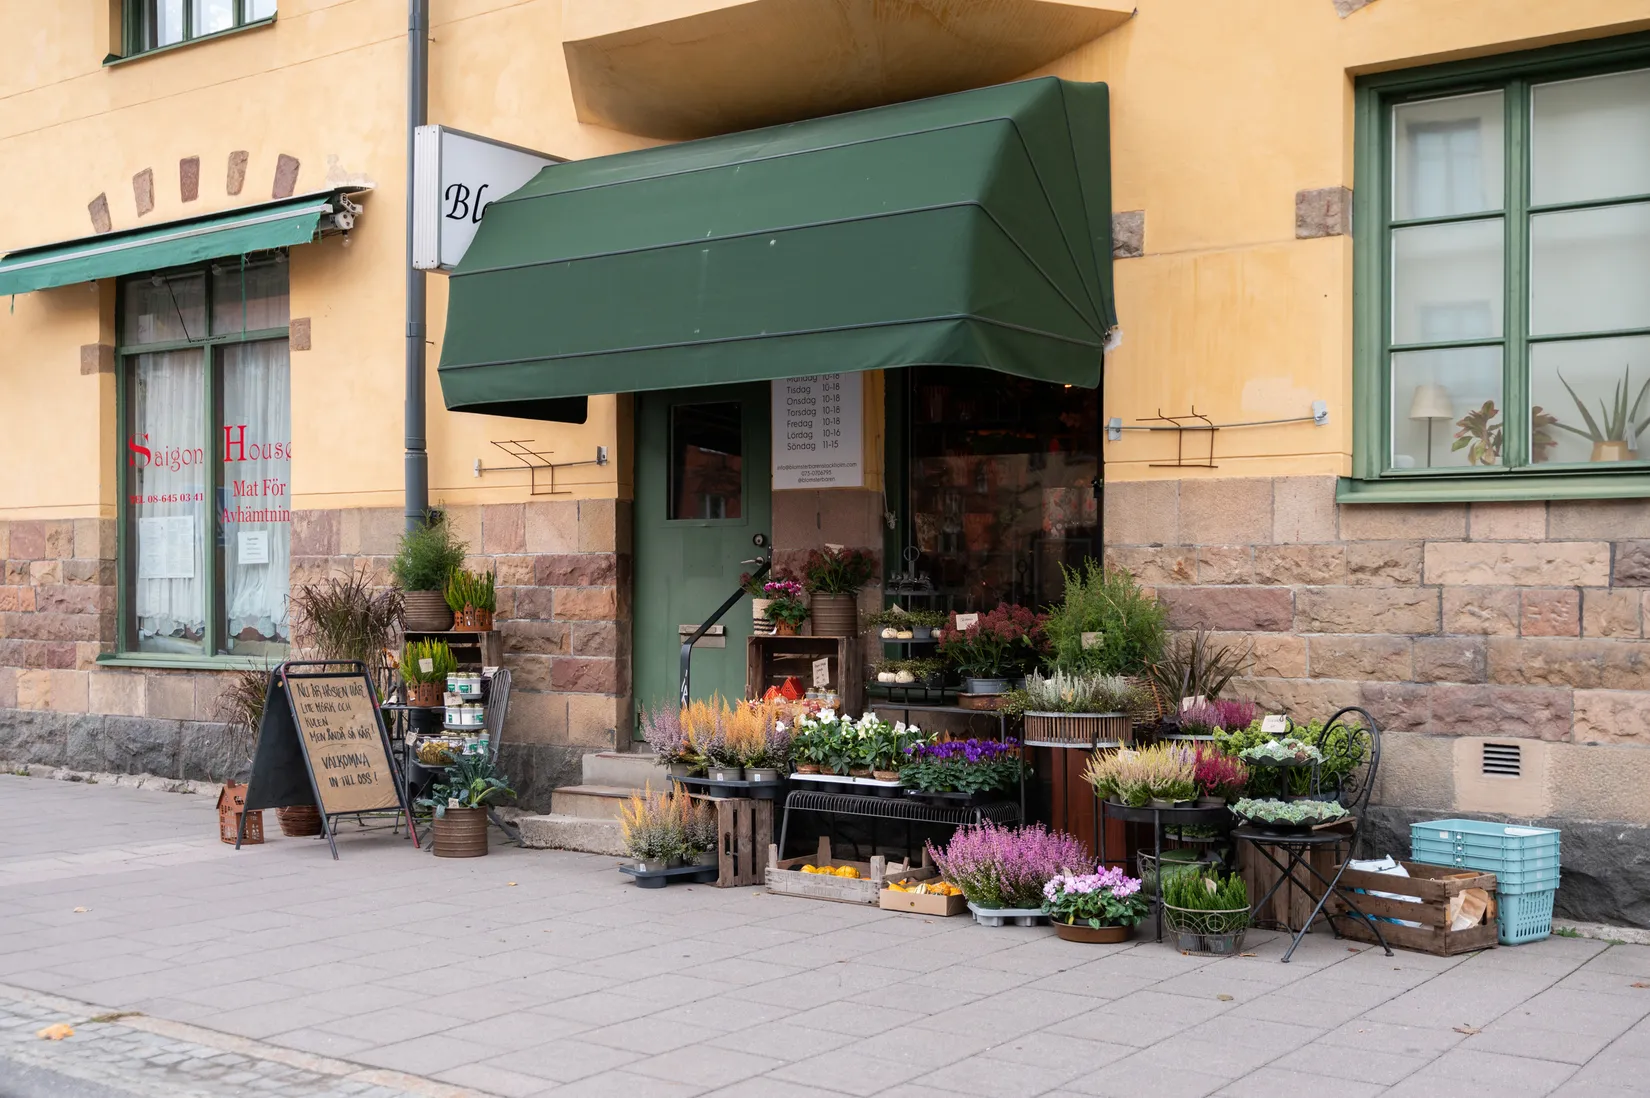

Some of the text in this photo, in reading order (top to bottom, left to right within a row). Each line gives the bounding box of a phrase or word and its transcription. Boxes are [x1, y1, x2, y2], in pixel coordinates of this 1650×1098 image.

[786, 383, 840, 395] Tisdag 10-18
[786, 394, 840, 406] Onsdag 10-18
[787, 405, 840, 417] Torsdag 10-18
[787, 417, 840, 429] Fredag 10-18
[787, 428, 841, 440] Lördag 10-16
[787, 440, 839, 451] Söndag 11-15
[128, 433, 204, 472] Saigon
[232, 478, 286, 497] Mat För
[147, 494, 178, 504] 08-645
[179, 493, 191, 502] 03
[193, 492, 204, 501] 41
[338, 702, 352, 712] OCH
[309, 730, 327, 743] MEN
[328, 775, 339, 788] IN
[339, 774, 356, 787] TILL
